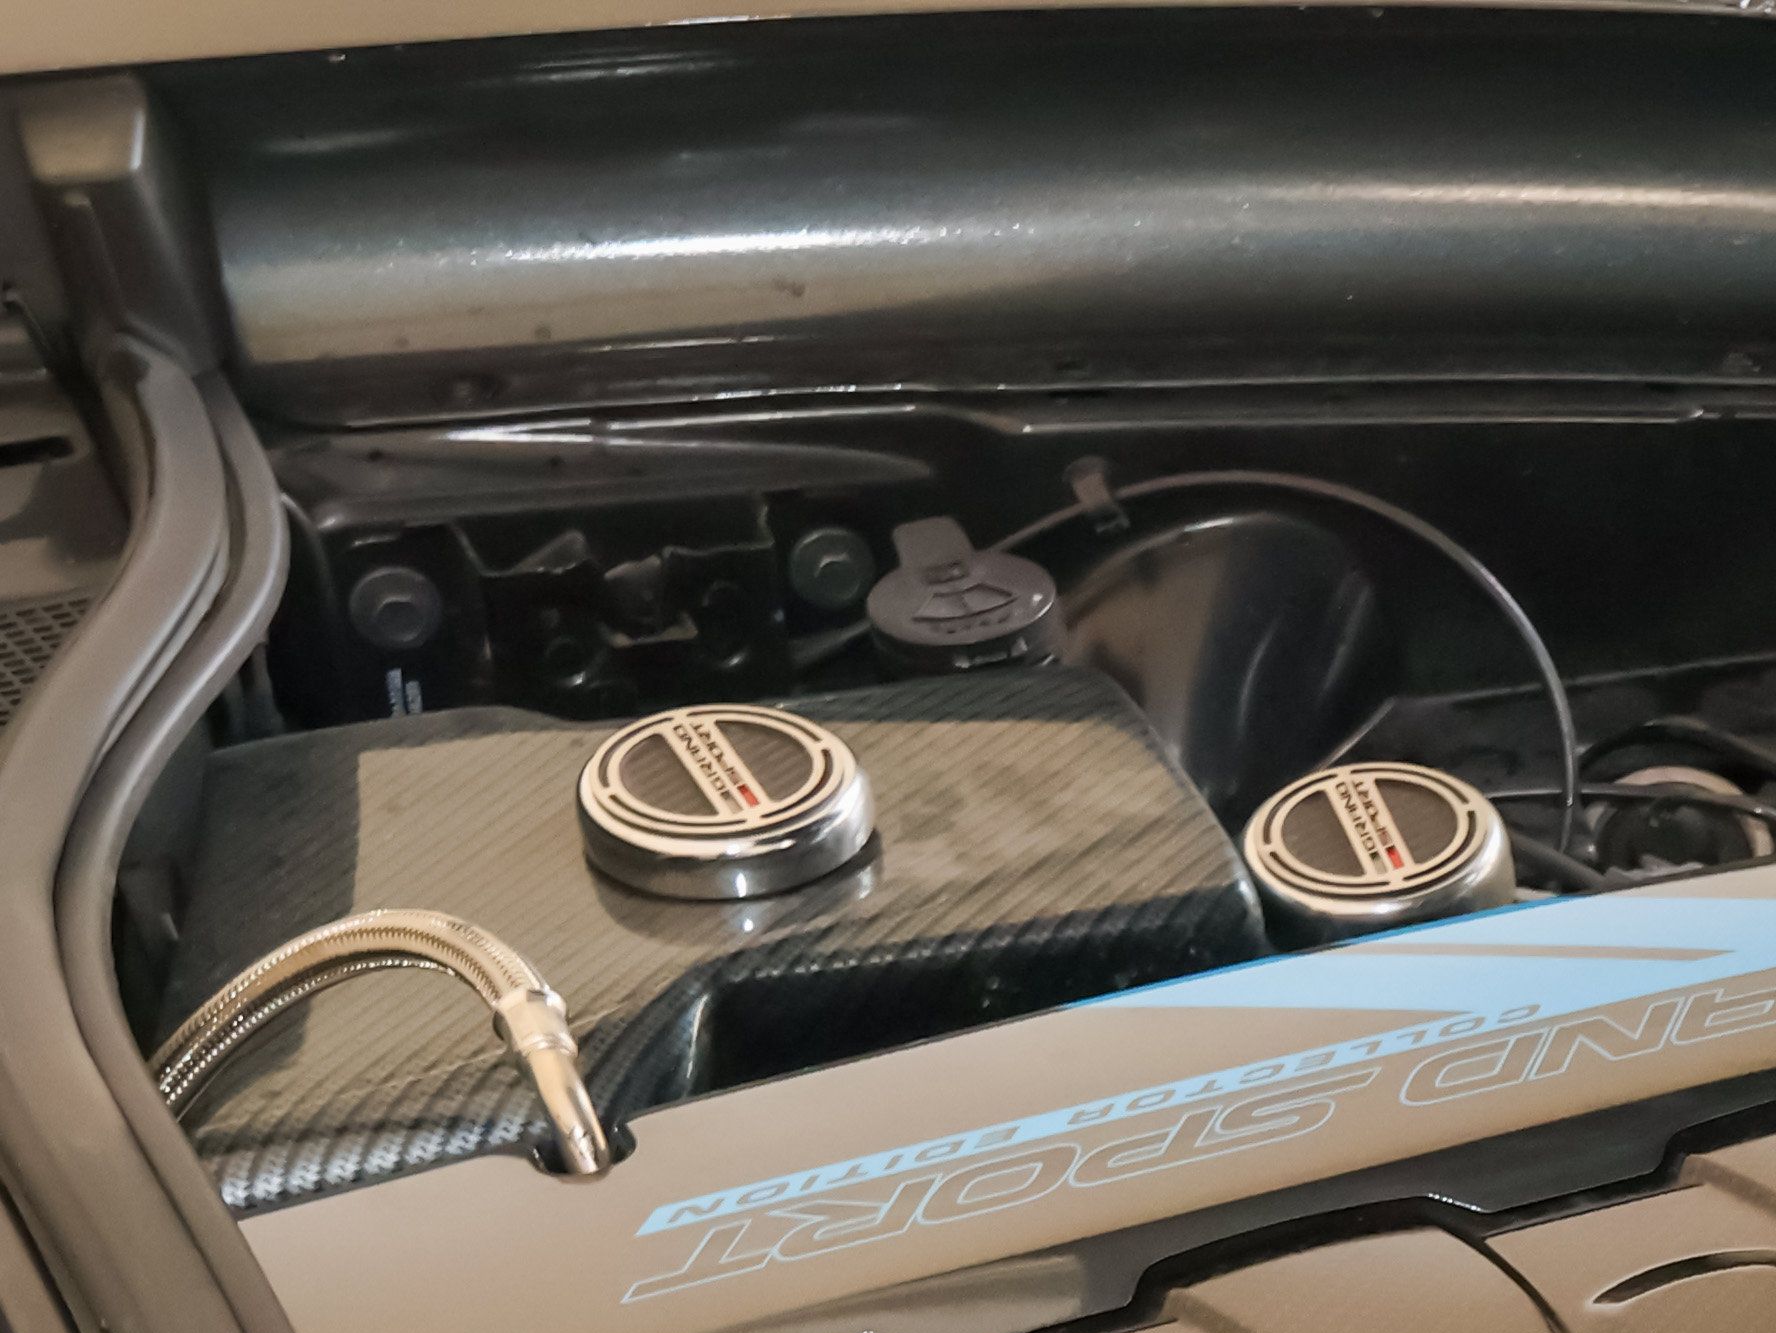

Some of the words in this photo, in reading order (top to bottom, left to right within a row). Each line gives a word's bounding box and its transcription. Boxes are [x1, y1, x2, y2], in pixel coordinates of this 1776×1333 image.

[673, 724, 726, 791] GRAND
[689, 722, 742, 786] SPORT
[1335, 781, 1376, 851] GRAND
[1354, 780, 1393, 846] SPORT
[1064, 1004, 1541, 1128] COLLECTOR
[621, 1064, 1383, 1304] SPORT
[671, 1121, 1020, 1219] EDITION
